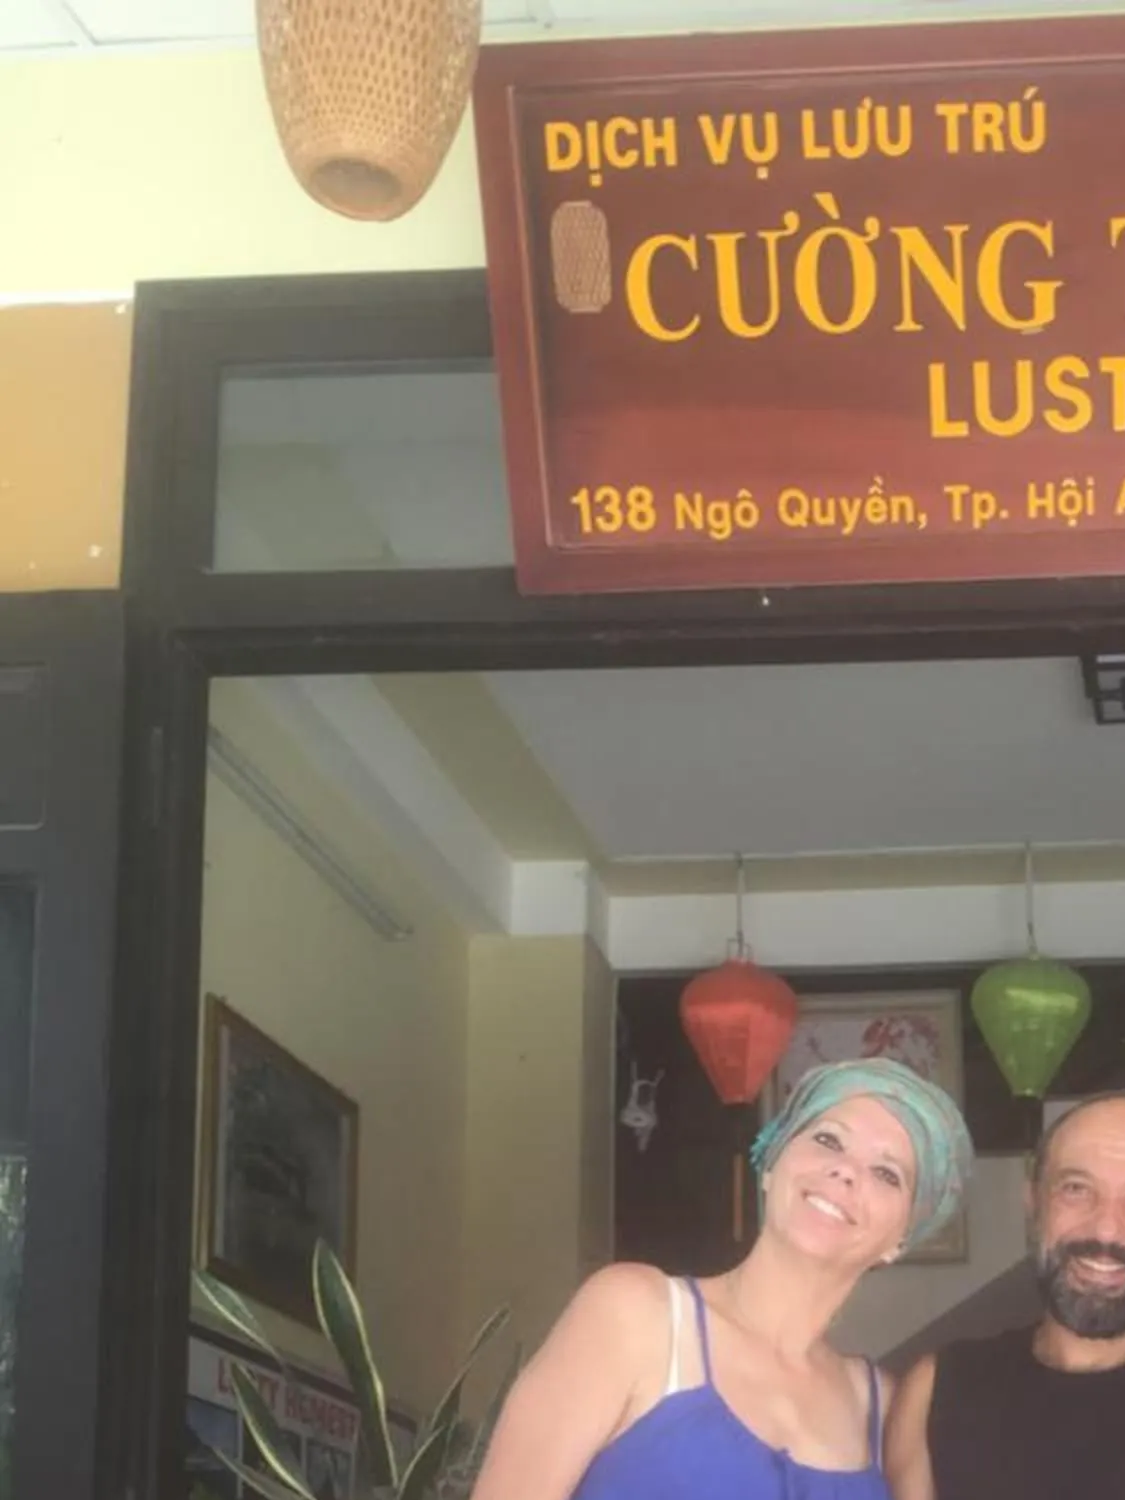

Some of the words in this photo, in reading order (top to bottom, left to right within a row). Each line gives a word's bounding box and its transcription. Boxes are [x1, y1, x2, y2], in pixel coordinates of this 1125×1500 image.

[545, 116, 678, 186] DỊCH
[698, 112, 780, 180] VỤ
[802, 97, 912, 160] LƯU
[936, 86, 1047, 154] TRÚ
[625, 192, 1065, 341] CƯỜNG
[571, 485, 657, 533] 138
[674, 489, 760, 541] Ngô
[777, 476, 929, 534] Quyền,
[943, 484, 1009, 529] Tp.
[1027, 478, 1095, 528] Hội
